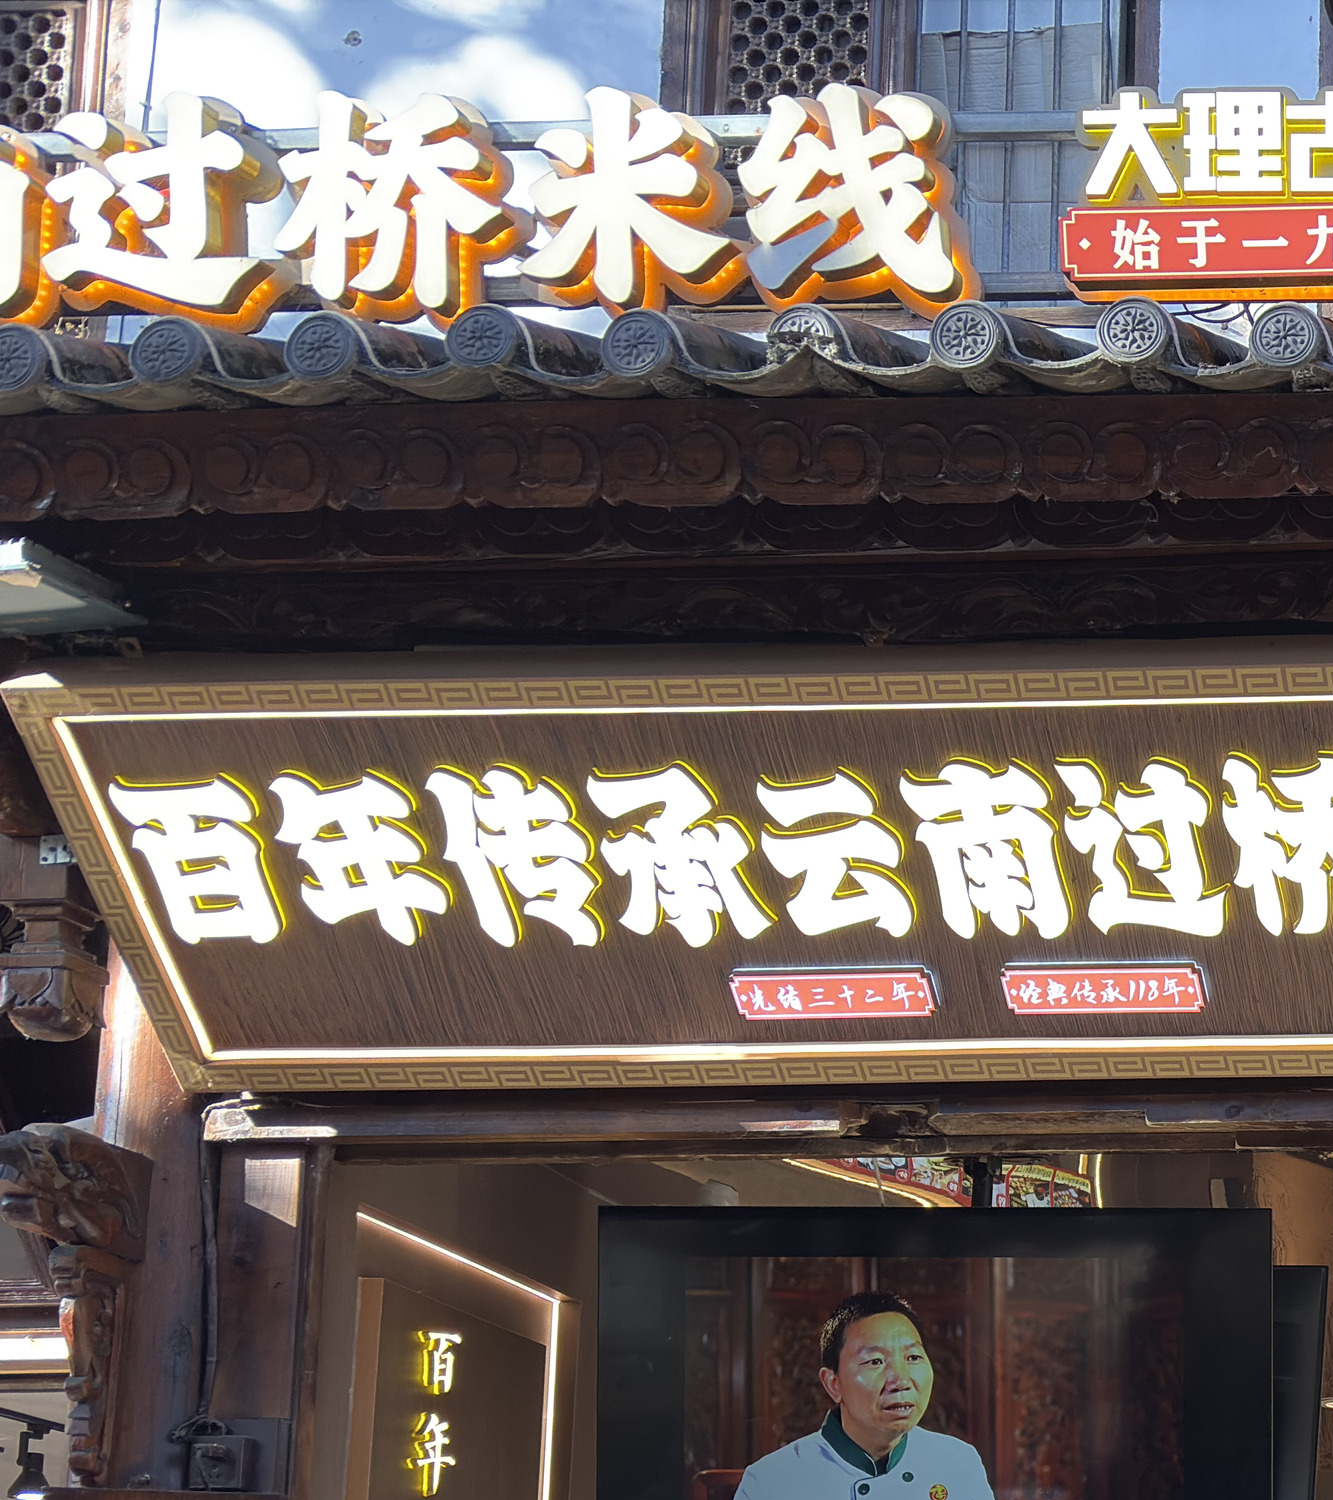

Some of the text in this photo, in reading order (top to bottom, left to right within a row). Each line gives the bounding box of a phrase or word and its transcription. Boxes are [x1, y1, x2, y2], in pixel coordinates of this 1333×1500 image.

[0, 84, 956, 308] 过桥米线
[747, 980, 915, 1012] 光绪三十二年
[1018, 976, 1184, 1006] 经典传承118年
